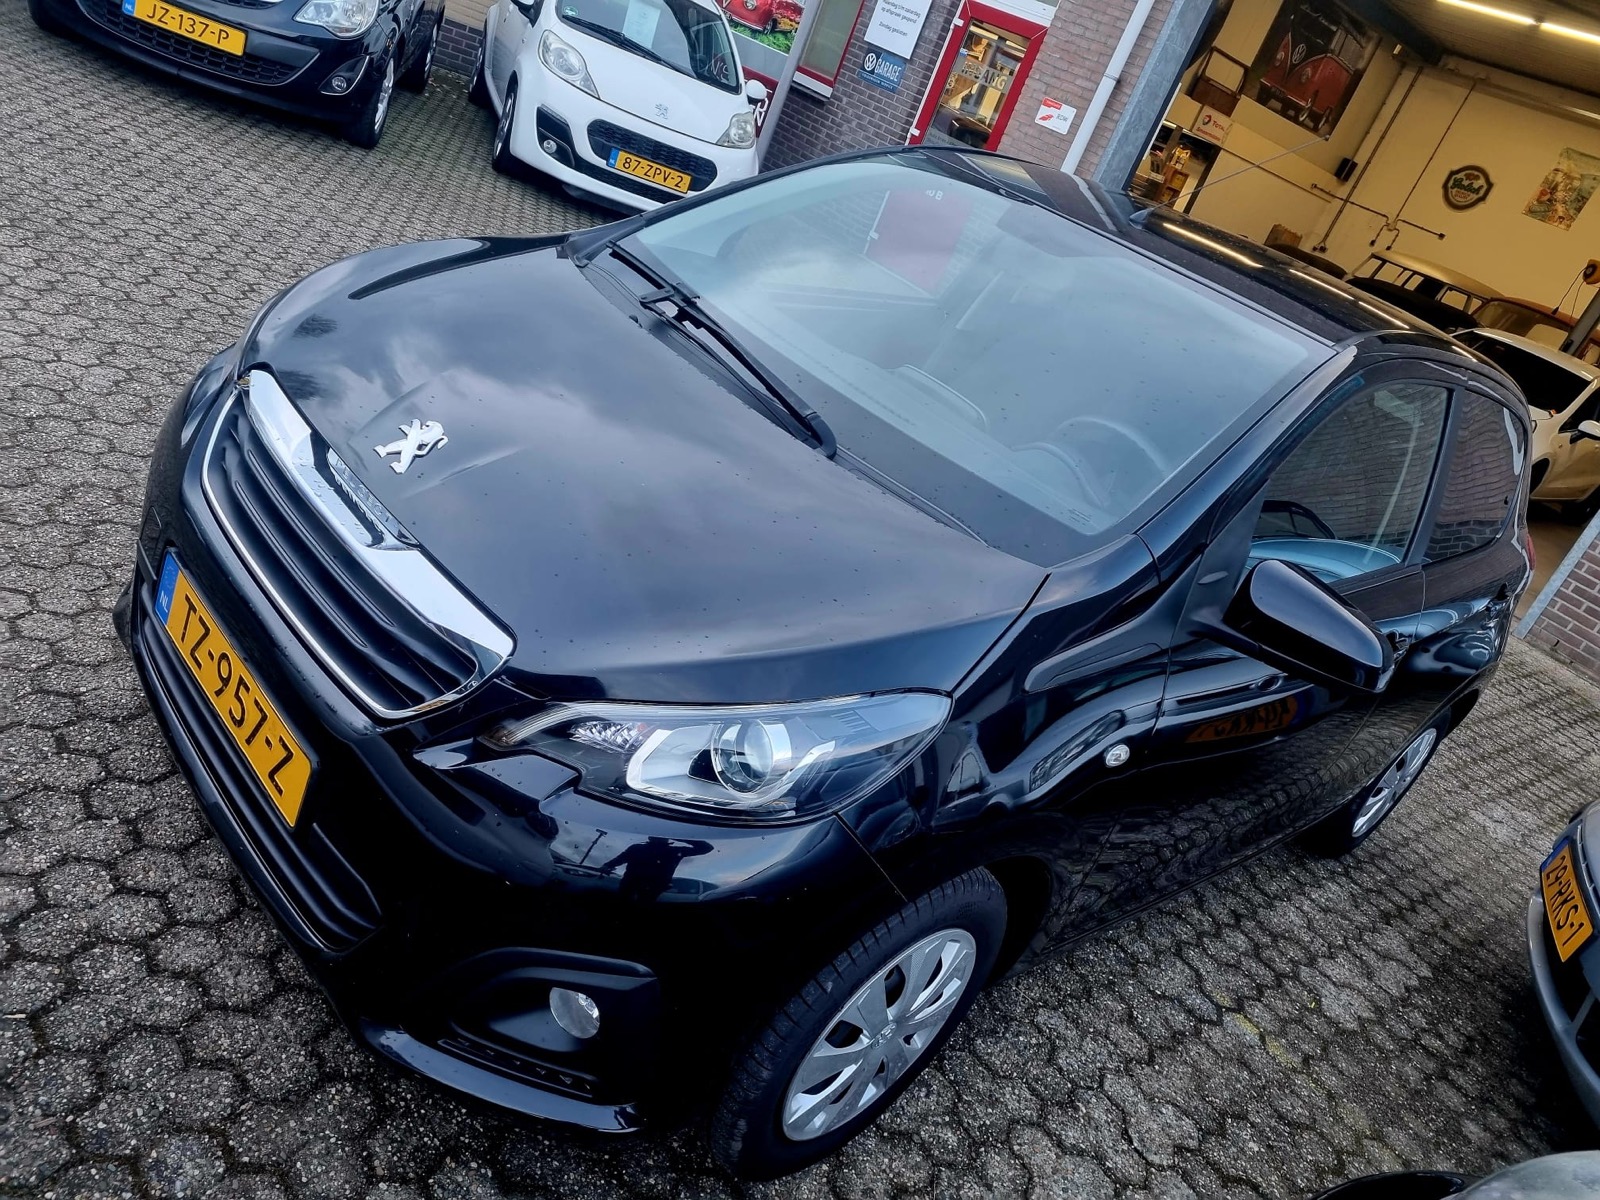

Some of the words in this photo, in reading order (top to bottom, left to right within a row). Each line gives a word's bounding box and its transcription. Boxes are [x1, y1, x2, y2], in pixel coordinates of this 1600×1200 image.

[146, 3, 230, 45] JZ-137-P
[875, 58, 902, 82] GARAGE
[622, 156, 684, 189] 87-ZPV-2
[159, 590, 169, 613] NL
[179, 592, 295, 798] TZ-957-Z
[1545, 854, 1585, 948] 29-RKS-1
